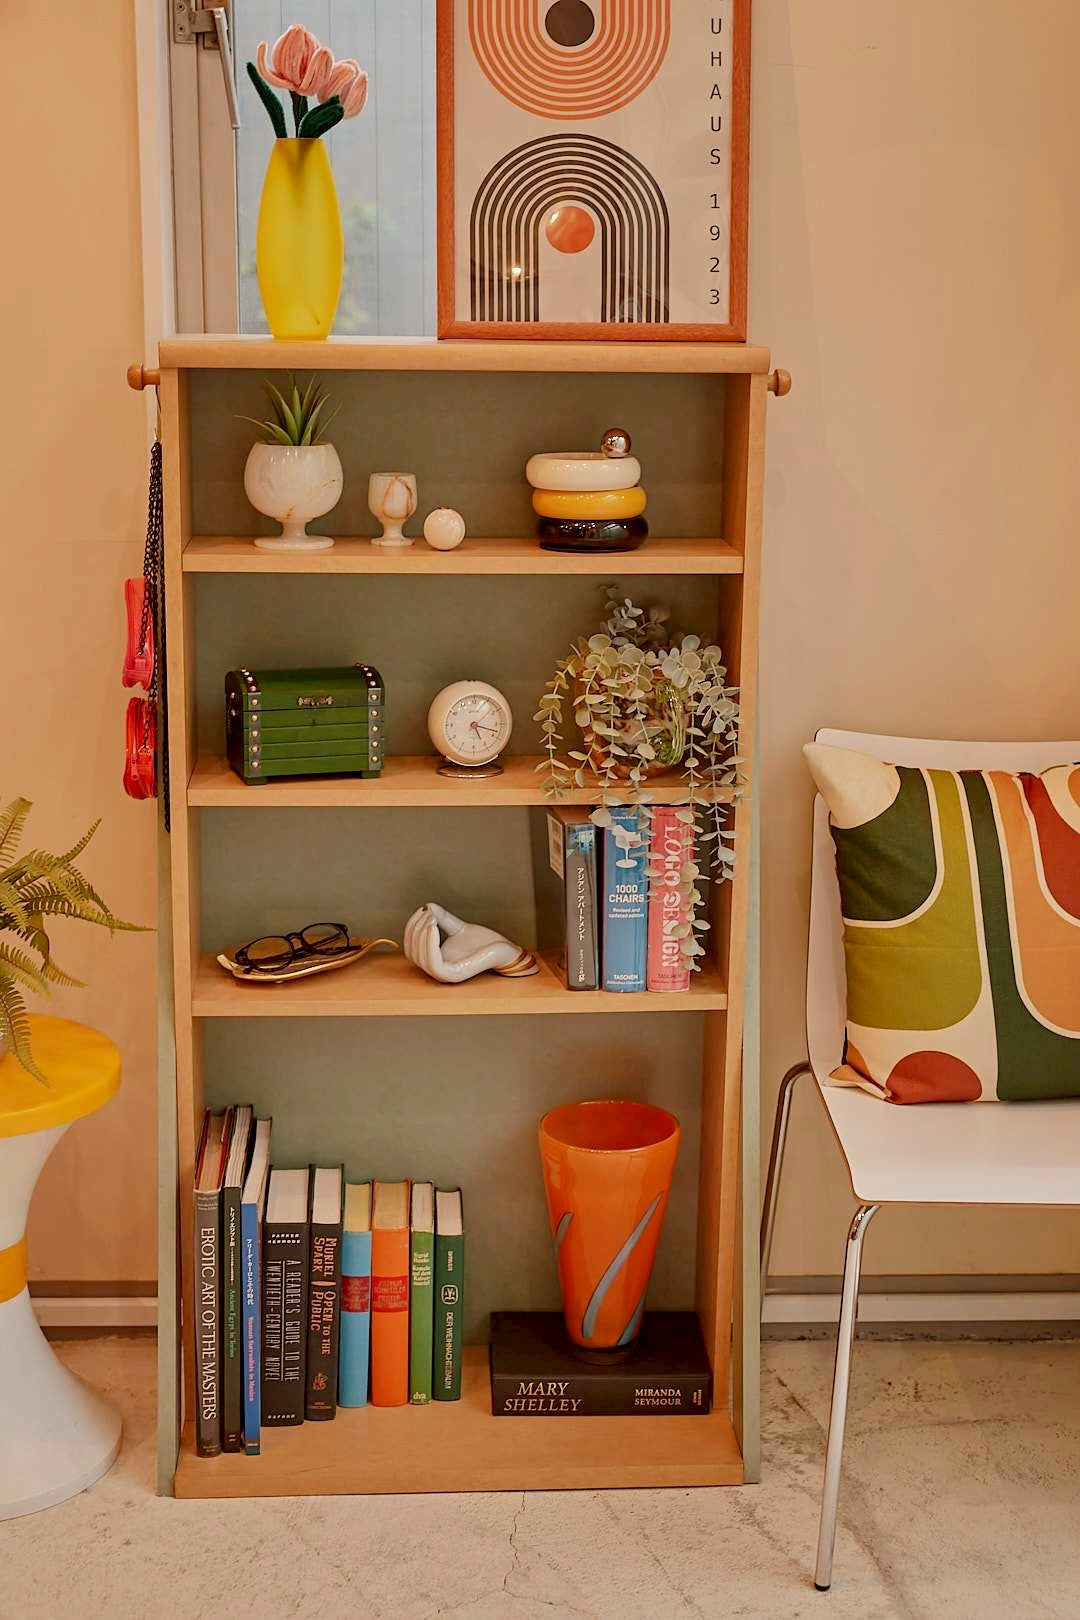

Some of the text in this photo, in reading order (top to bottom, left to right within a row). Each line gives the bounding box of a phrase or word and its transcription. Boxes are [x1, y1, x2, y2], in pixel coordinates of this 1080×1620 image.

[708, 193, 721, 306] 1923
[664, 824, 682, 887] LOGO
[608, 894, 645, 903] CHAIRS
[615, 884, 638, 894] 1000
[662, 890, 681, 967] DESIGN
[200, 1227, 216, 1278] EROTIC
[311, 1237, 325, 1273] SPARK
[324, 1237, 337, 1277] MURIEL
[201, 1281, 216, 1308] ART
[285, 1272, 302, 1314] READER'S
[201, 1310, 216, 1330] OF
[265, 1261, 282, 1381] TWENTIETH-CENTURY NOVEL
[311, 1291, 324, 1332] PUBLIC
[321, 1291, 337, 1355] OPEN TO THE
[446, 1312, 454, 1327] DER
[202, 1330, 217, 1359] THE
[285, 1321, 301, 1344] GUIDE
[284, 1352, 300, 1361] TO
[284, 1367, 300, 1381] THE
[202, 1361, 217, 1420] MASTERS
[516, 1382, 570, 1396] MARY
[634, 1388, 682, 1397] MIRANDA
[634, 1398, 682, 1406] SEYMOUR
[503, 1398, 582, 1412] SHELLEY
